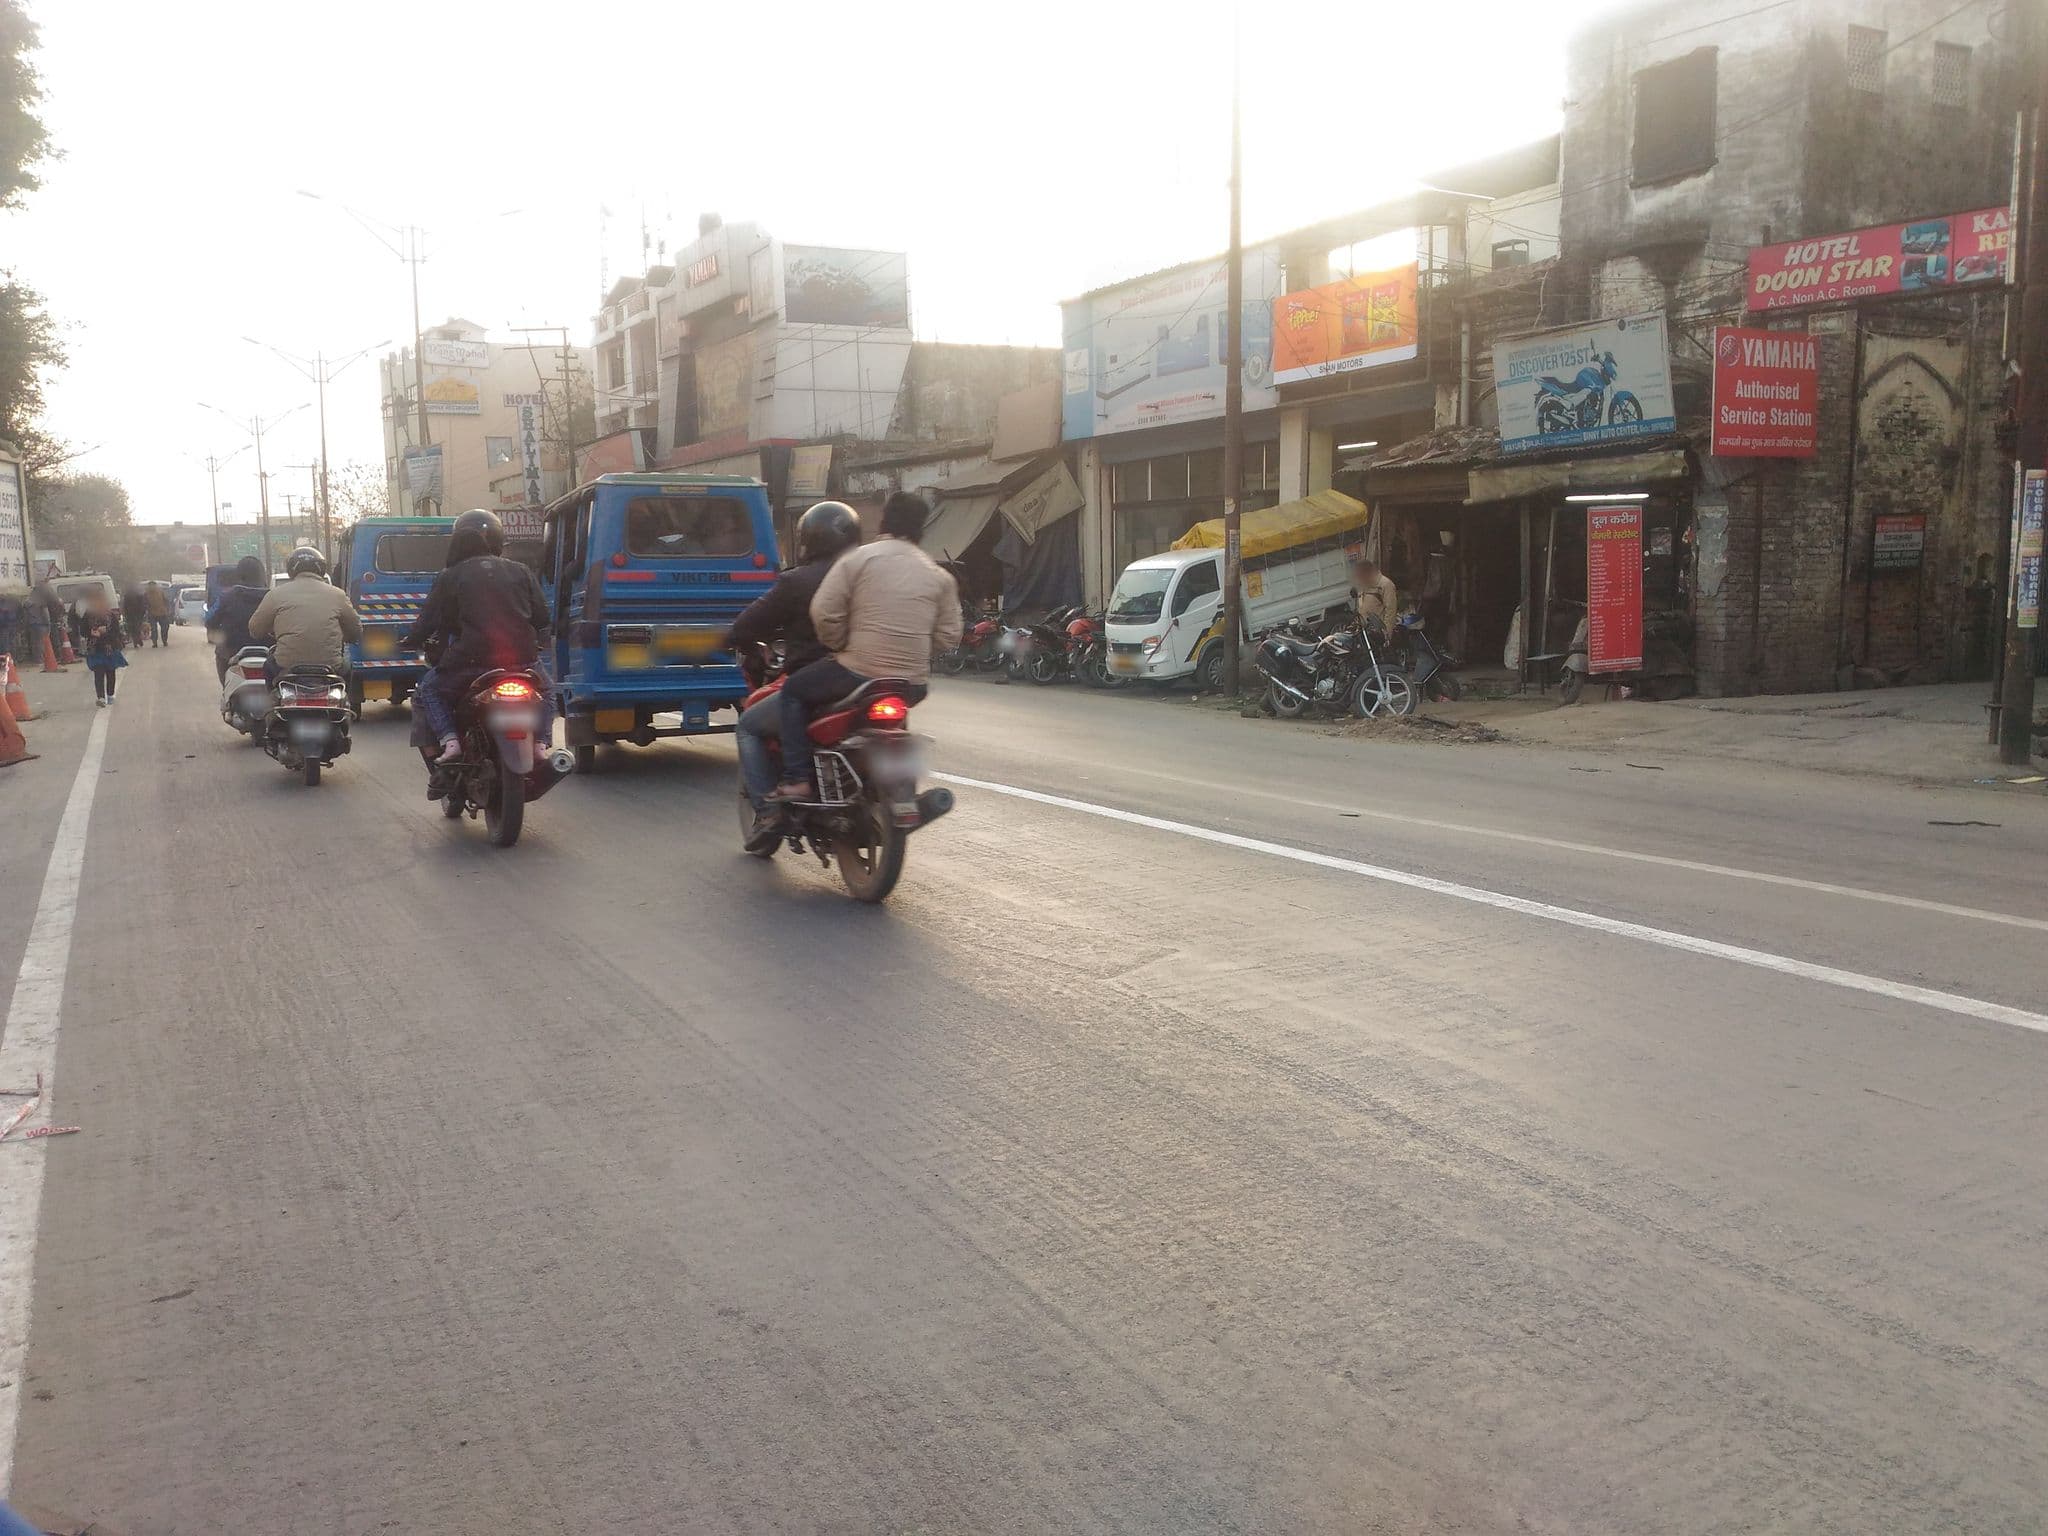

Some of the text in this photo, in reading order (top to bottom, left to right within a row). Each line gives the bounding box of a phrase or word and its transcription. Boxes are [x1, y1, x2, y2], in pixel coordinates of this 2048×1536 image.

[1973, 210, 2009, 232] KA
[1784, 235, 1861, 266] HOTEL
[1979, 231, 2009, 252] RE
[1754, 255, 1894, 294] DOON STAR
[1767, 284, 1876, 308] A.C. Non A.C. Room
[1337, 358, 1364, 370] MOTORS
[1742, 338, 1816, 370] YAMAHA
[1509, 353, 1559, 378] DISCOVER
[1736, 379, 1800, 400] Authorised
[1721, 405, 1812, 426] Service Station
[503, 526, 543, 536] HALIMAR
